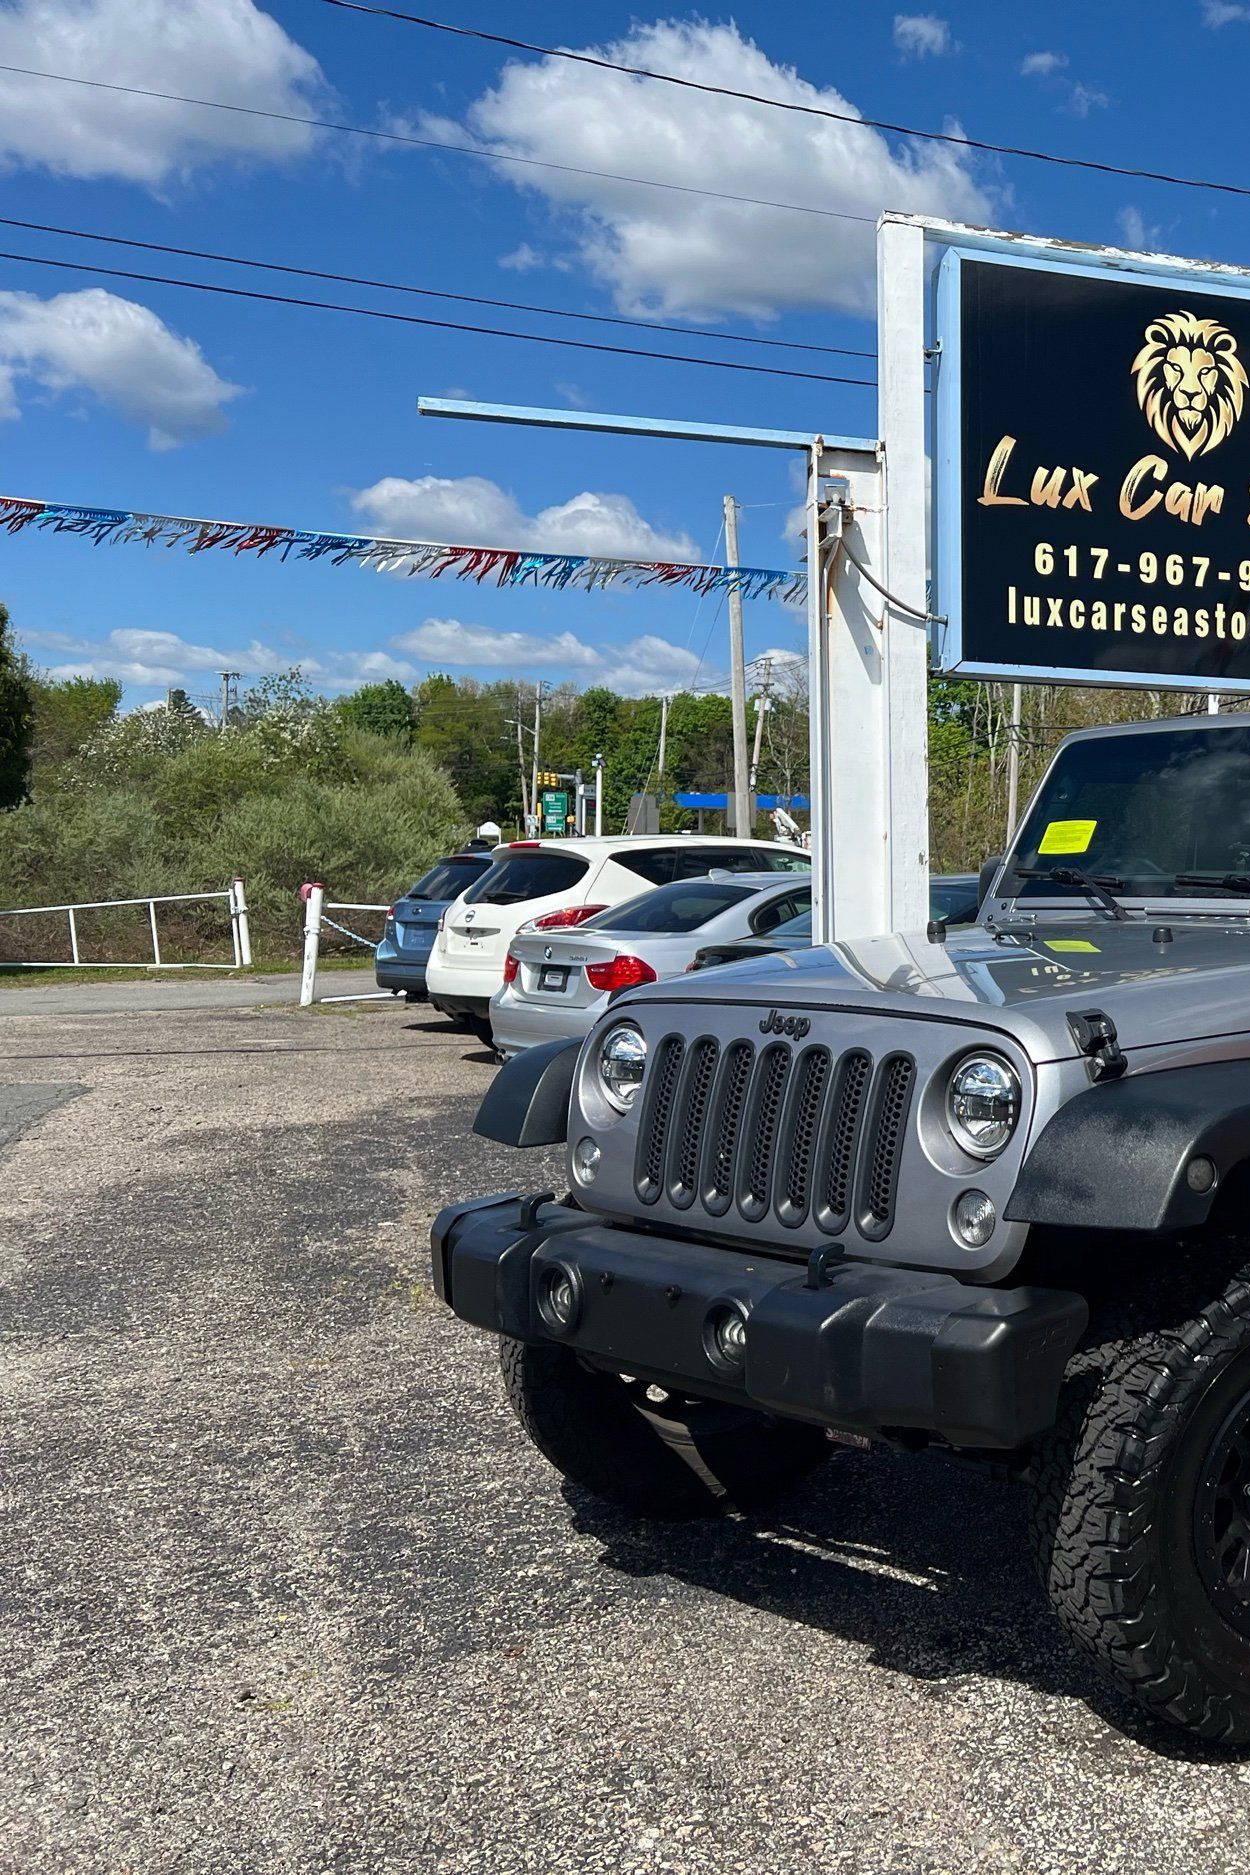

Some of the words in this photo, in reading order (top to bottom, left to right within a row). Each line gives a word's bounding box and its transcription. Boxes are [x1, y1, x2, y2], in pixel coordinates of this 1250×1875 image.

[977, 435, 1099, 512] Lux
[1119, 454, 1225, 526] Car
[759, 1009, 811, 1041] Jeep
